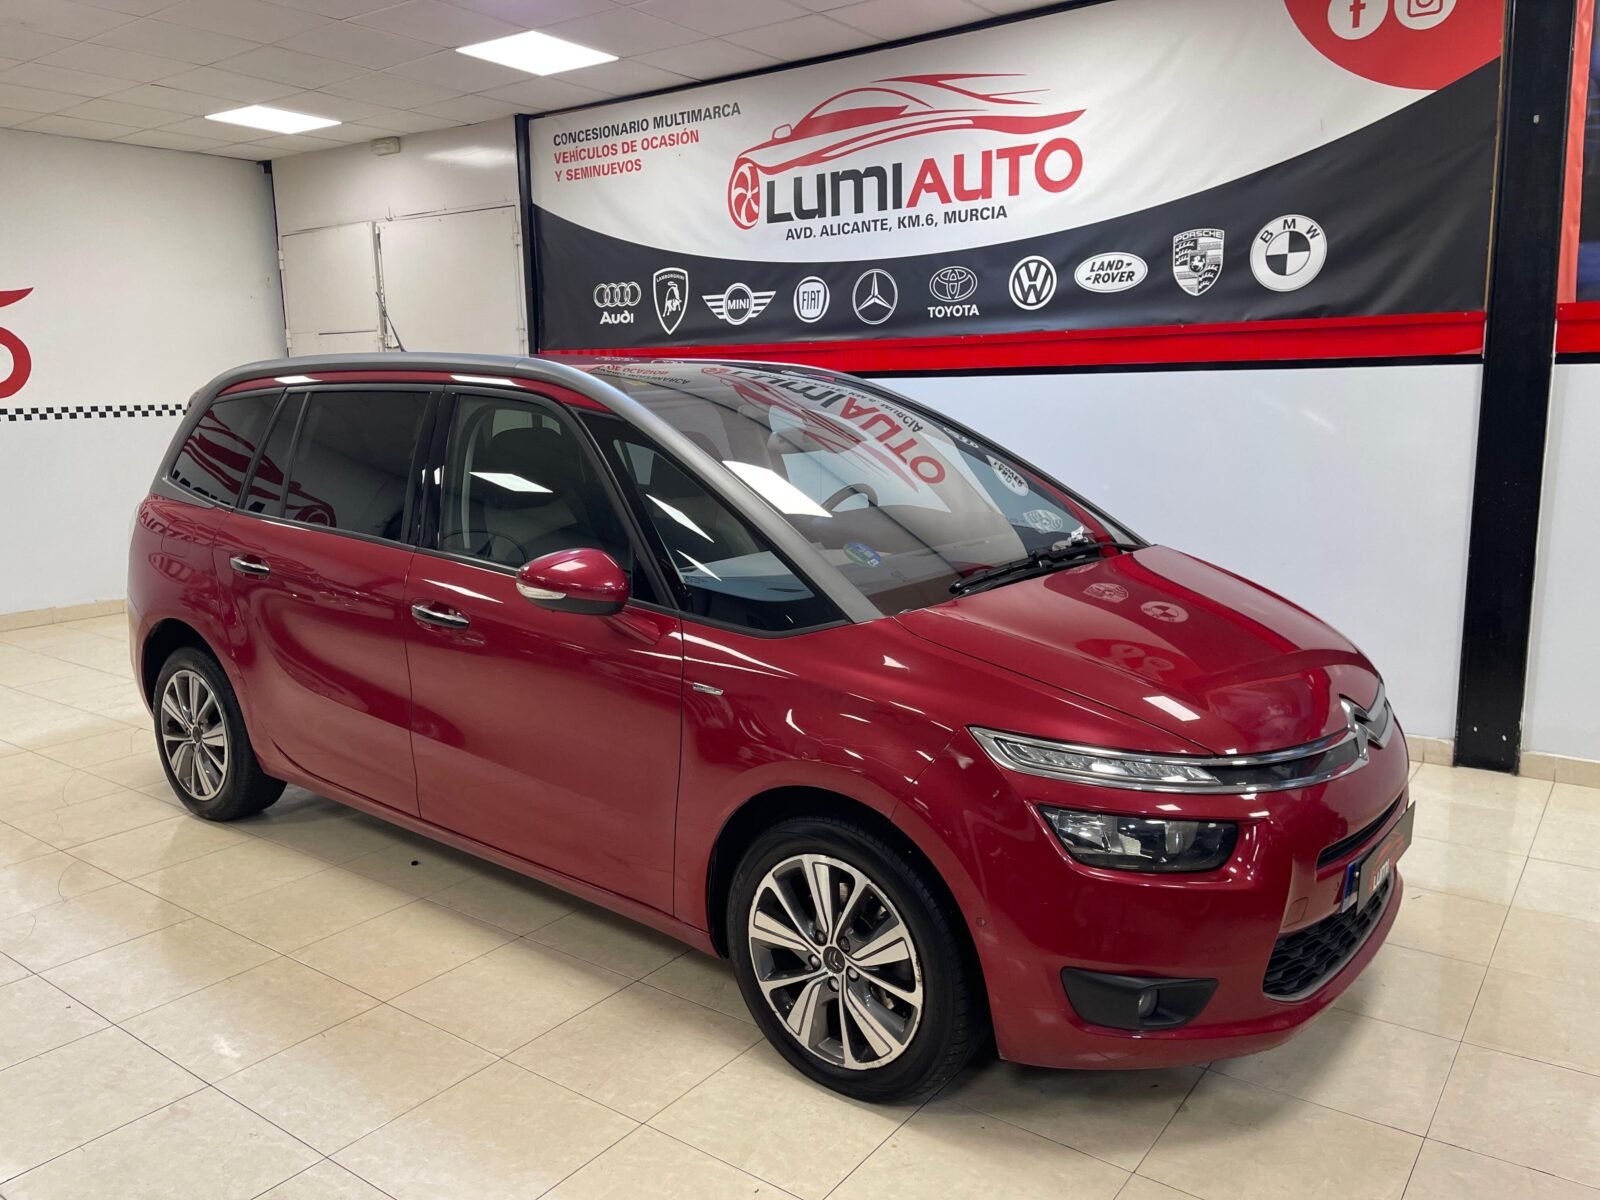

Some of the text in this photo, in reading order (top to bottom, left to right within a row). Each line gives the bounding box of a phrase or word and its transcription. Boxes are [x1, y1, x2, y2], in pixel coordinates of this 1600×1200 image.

[553, 102, 742, 147] CONCESIONARIO MULTIMARCA
[553, 128, 700, 164] VEHÍCULOS DE OCASIÓN
[555, 159, 642, 182] Y SEMINUEVOS
[785, 205, 1008, 241] AVD. ALICANTE, KM.6, MURCIA
[1260, 218, 1321, 244] BMW
[1174, 229, 1223, 243] PORSCHE
[1090, 259, 1125, 273] LAND
[1092, 270, 1136, 285] ROVER
[727, 298, 750, 311] MINI
[801, 288, 822, 311] FIAT
[600, 310, 634, 325] Audi
[928, 304, 980, 318] TOYOTA
